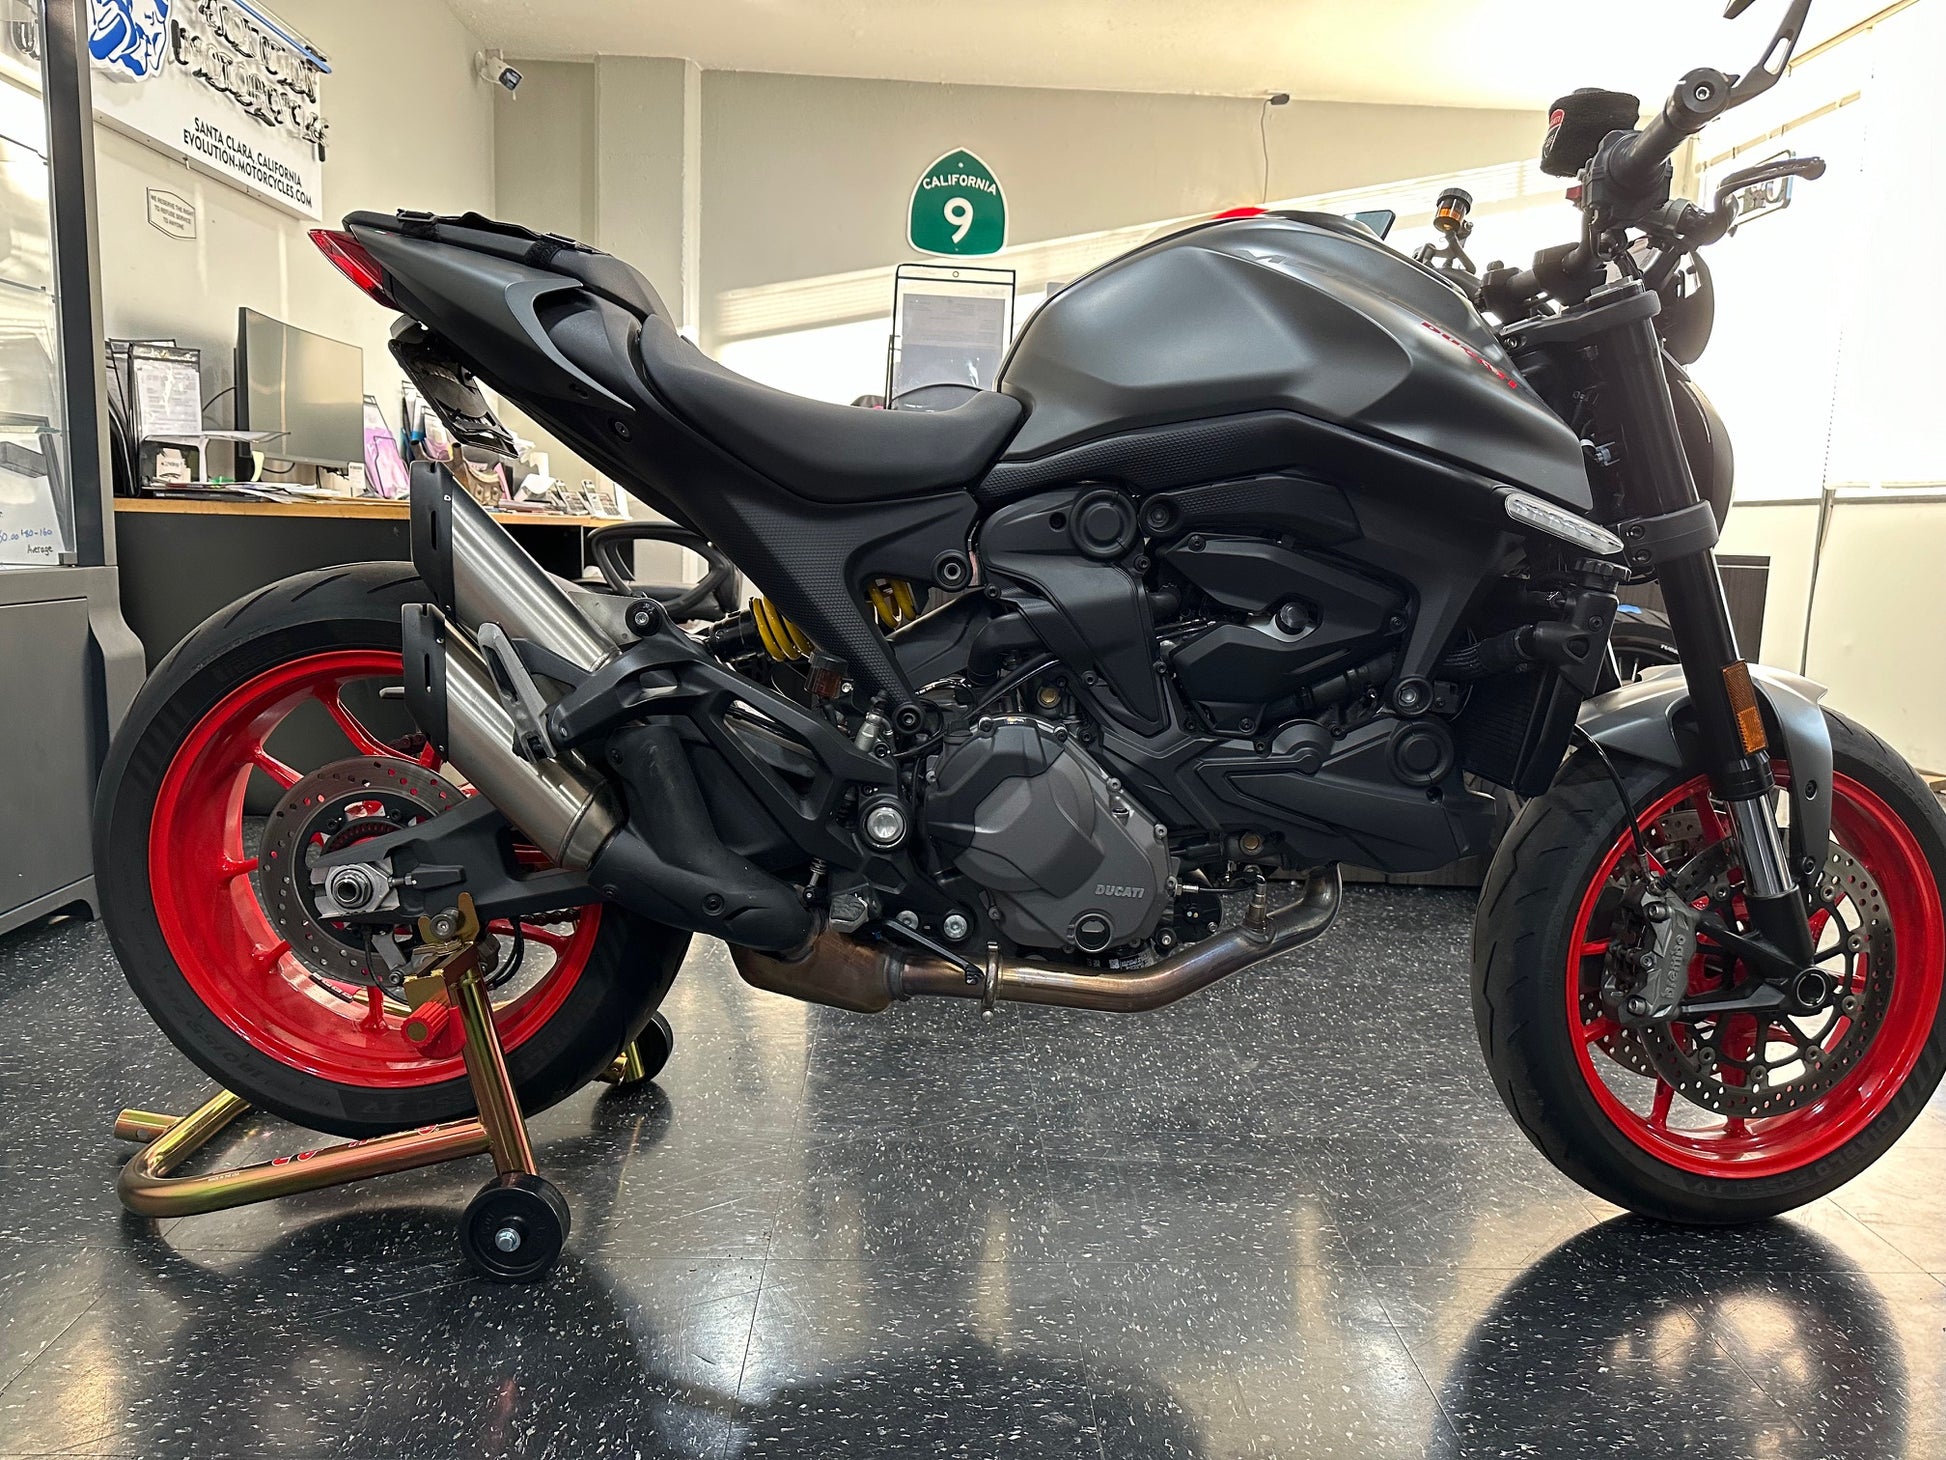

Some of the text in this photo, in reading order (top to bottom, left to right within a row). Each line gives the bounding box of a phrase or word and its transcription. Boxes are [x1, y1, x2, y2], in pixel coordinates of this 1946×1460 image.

[183, 128, 312, 208] EVOLUTION-MOTORCYCLES.COM
[194, 117, 224, 146] SANTA
[257, 153, 302, 188] CALIFORNIA
[922, 174, 997, 196] CALIFORNIA
[943, 197, 974, 244] 9
[1095, 884, 1145, 899] DUCATI
[1661, 933, 1686, 999] brembo
